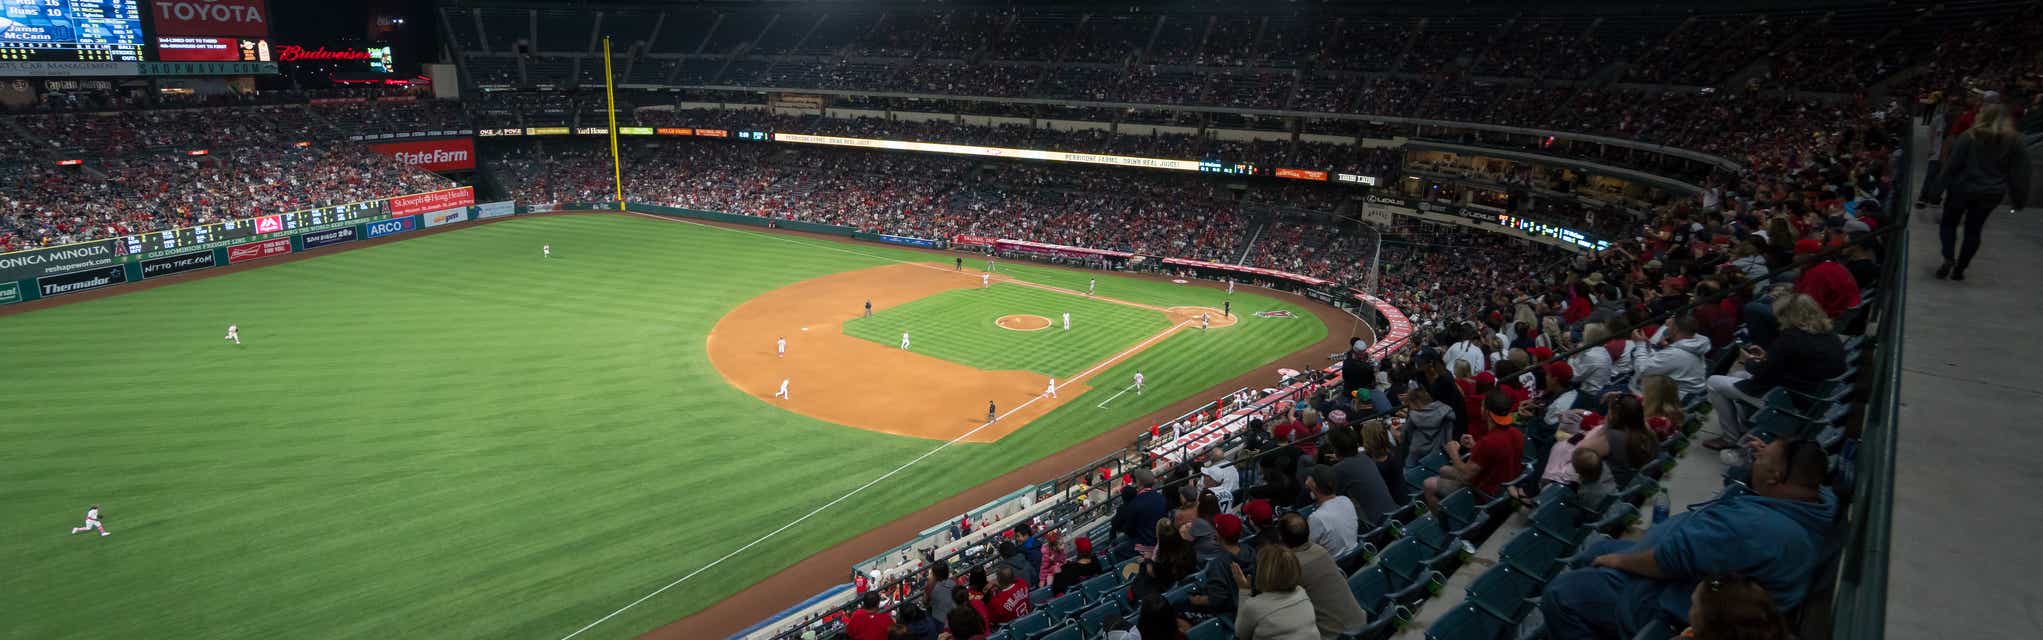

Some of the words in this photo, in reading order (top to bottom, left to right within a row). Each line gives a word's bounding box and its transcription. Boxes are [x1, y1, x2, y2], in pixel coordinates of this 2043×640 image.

[9, 6, 39, 16] Runs
[46, 8, 62, 17] 10
[156, 2, 263, 23] TOYOTA
[4, 32, 52, 40] McCann
[7, 25, 45, 33] James
[274, 45, 371, 62] Budweiser
[45, 80, 78, 91] Captain
[370, 220, 402, 236] ARCO
[49, 245, 110, 262] MINOLTA
[148, 250, 165, 259] OLD
[165, 245, 202, 256] DOMINION
[202, 239, 231, 250] FREIGHT
[45, 257, 112, 273] reshapework.com
[144, 261, 172, 273] NITTO
[174, 254, 212, 268] TIRE.COM
[42, 276, 111, 295] Thermador
[1220, 500, 1230, 513] 7
